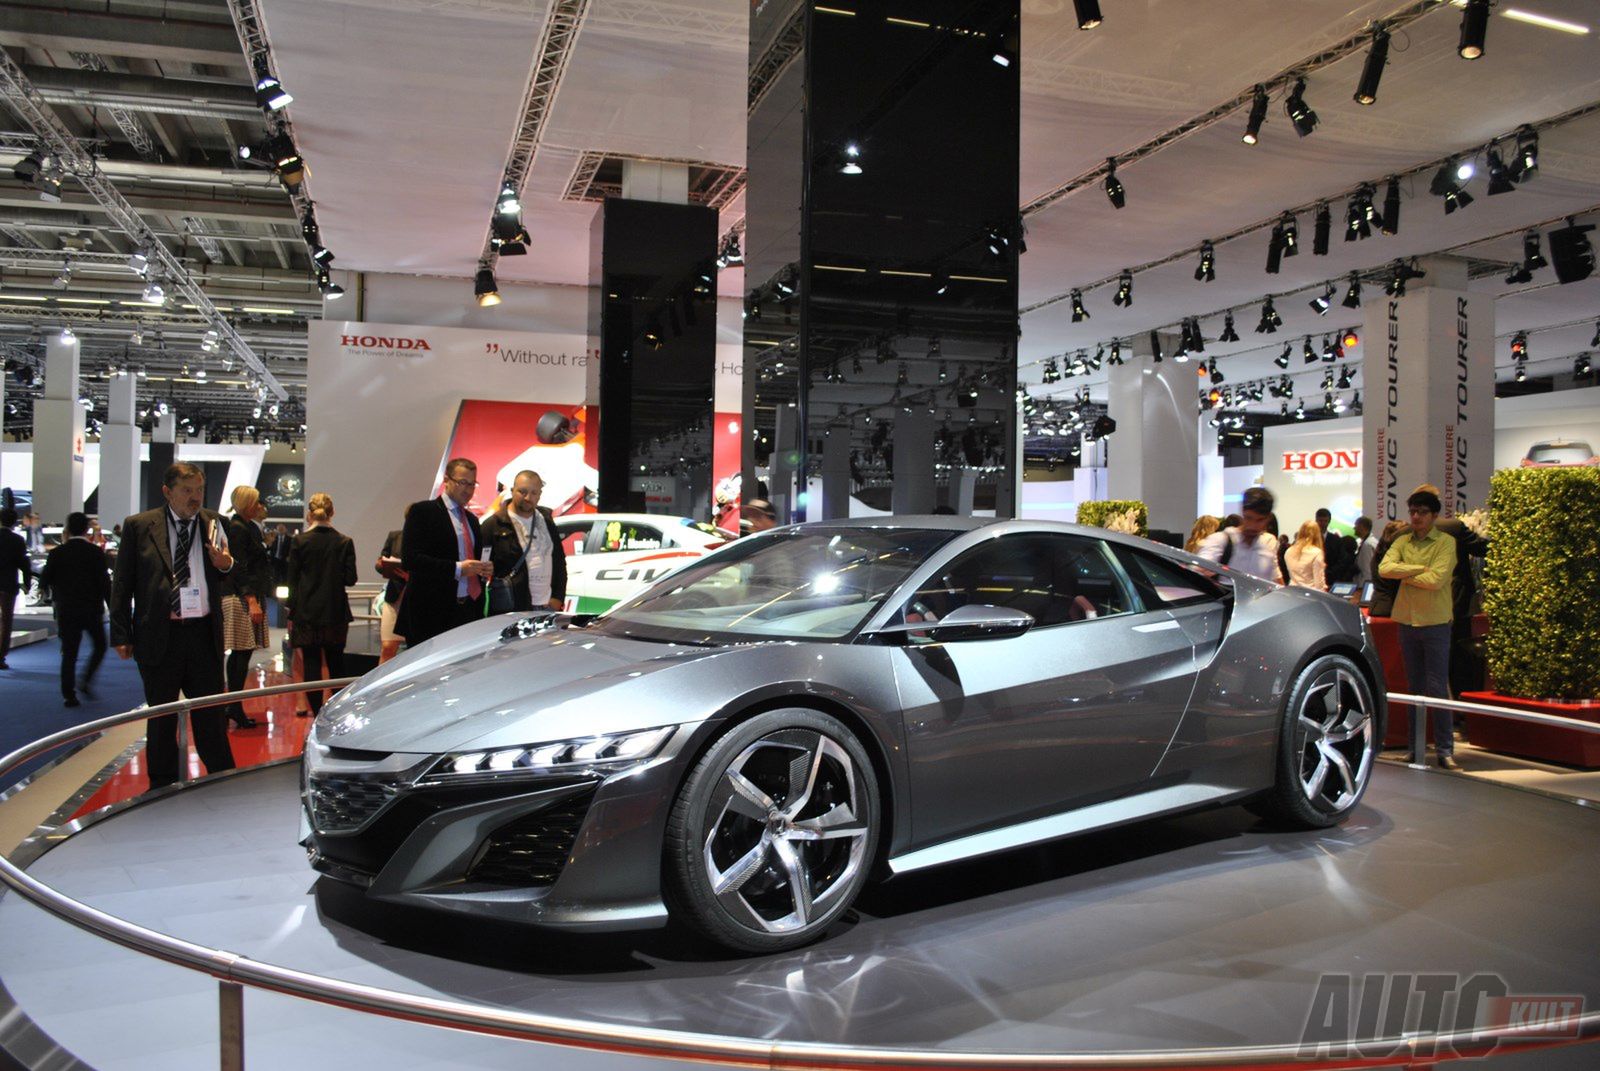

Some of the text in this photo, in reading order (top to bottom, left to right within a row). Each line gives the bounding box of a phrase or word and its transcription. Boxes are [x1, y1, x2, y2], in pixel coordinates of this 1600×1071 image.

[340, 335, 431, 350] HONDA
[396, 351, 424, 359] Dreams
[1457, 296, 1468, 426] TOURER
[1387, 301, 1398, 521] CIVIC TOURER
[1282, 450, 1361, 470] HON
[1376, 428, 1385, 519] WELTPREMIERE
[1444, 424, 1454, 519] WELTPREMIERE
